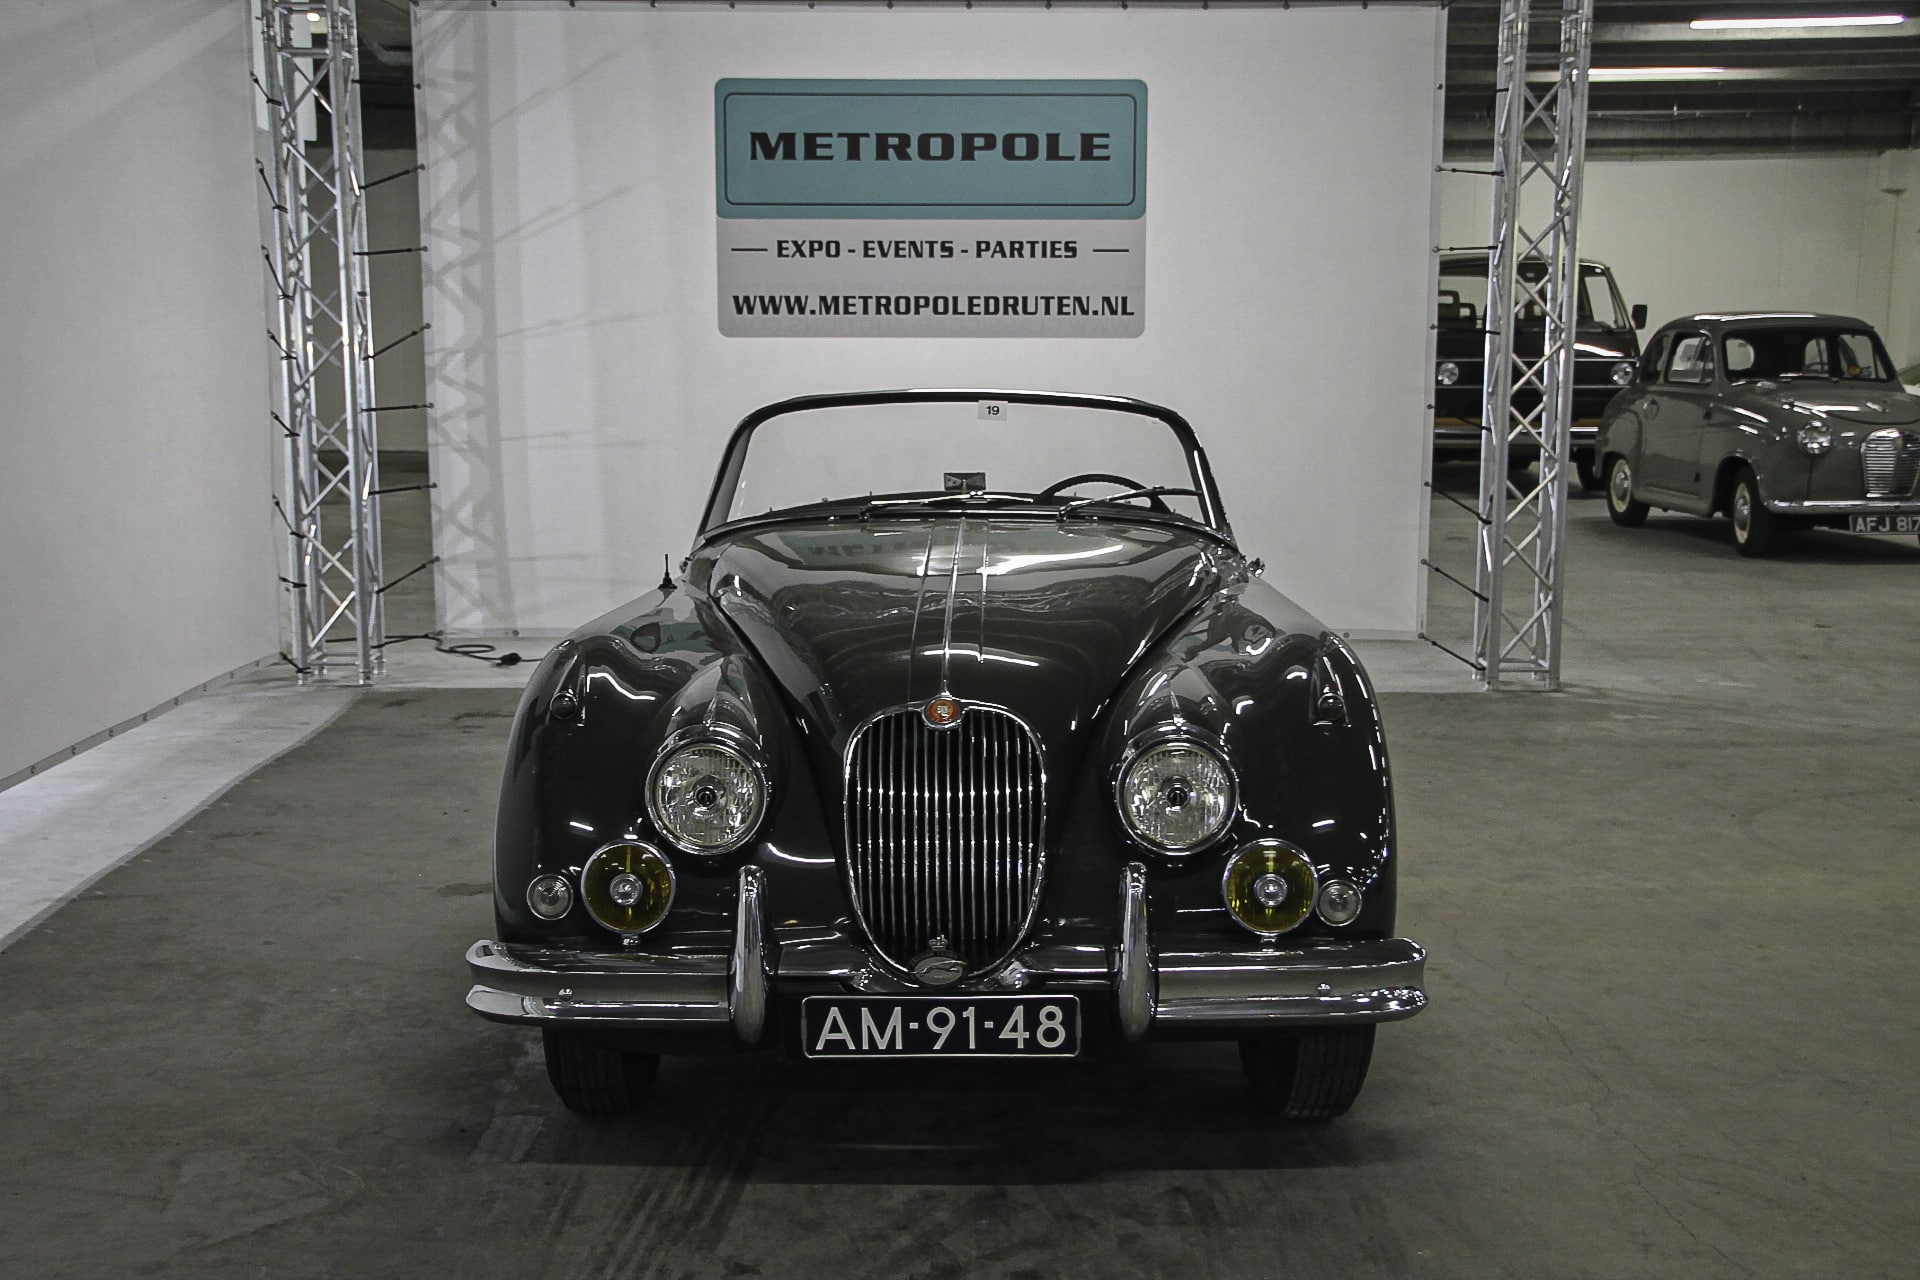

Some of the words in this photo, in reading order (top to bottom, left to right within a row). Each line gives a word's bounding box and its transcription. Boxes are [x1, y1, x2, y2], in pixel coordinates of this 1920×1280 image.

[749, 132, 1111, 161] METROPOLE
[776, 240, 841, 258] EXPO
[862, 240, 954, 259] EVENTS
[975, 240, 1078, 259] PARTIES
[732, 295, 1135, 317] WWW.METROPOLEDRUTEN.NL
[985, 405, 1000, 415] 19
[1855, 517, 1890, 532] AFJ
[1896, 516, 1920, 532] 817
[815, 1004, 1066, 1050] AM-91-48
